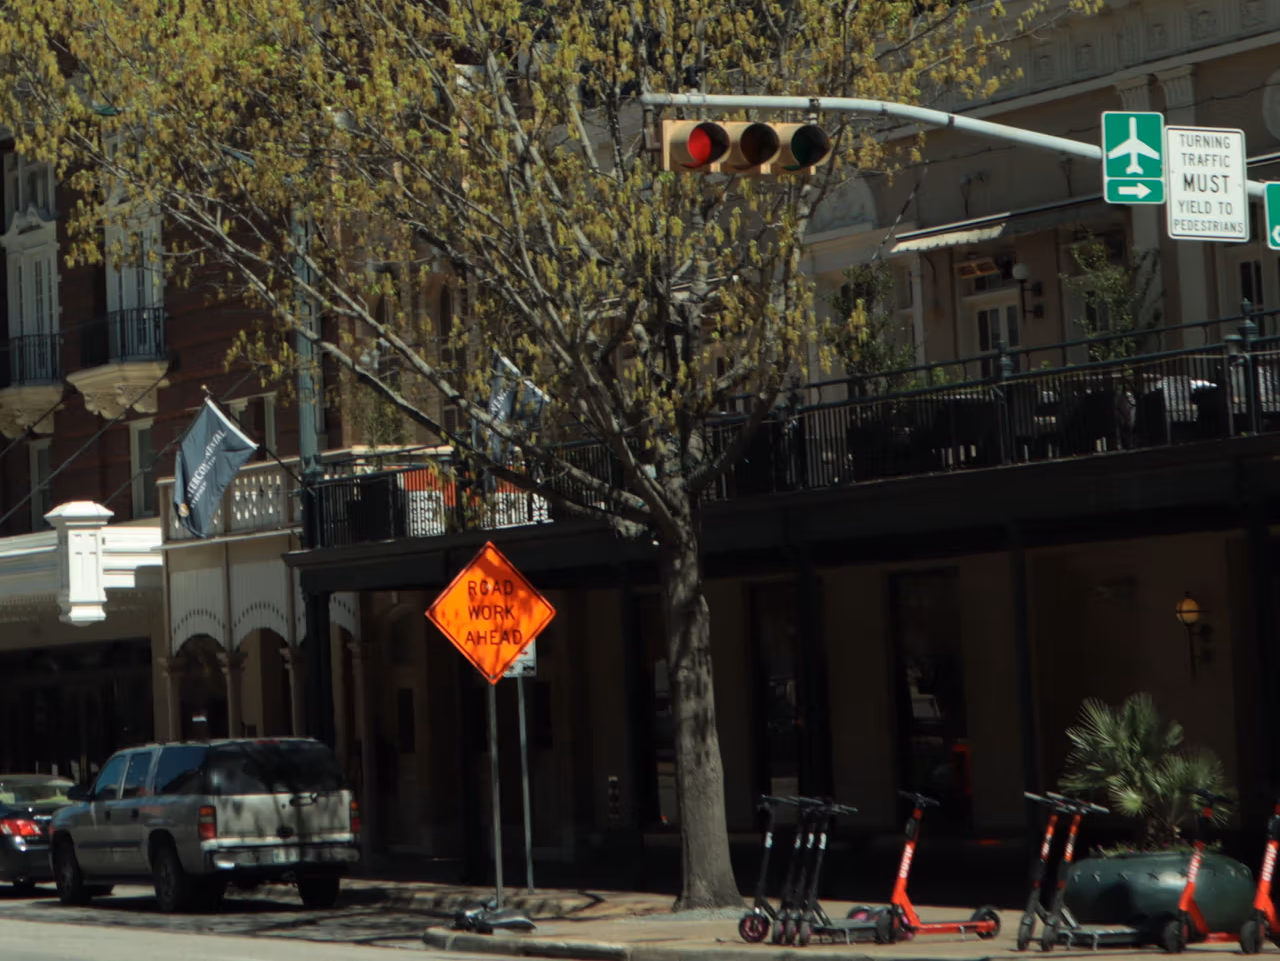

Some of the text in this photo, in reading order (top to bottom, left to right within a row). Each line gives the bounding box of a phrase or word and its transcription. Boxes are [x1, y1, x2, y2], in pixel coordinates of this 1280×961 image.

[1178, 134, 1231, 149] TURNING
[1181, 153, 1231, 168] TRAFFIC
[1183, 173, 1231, 194] MUST
[1177, 200, 1233, 216] YIELD TO
[1173, 219, 1244, 234] PEDESTRIANS
[467, 580, 514, 596] ROAD
[468, 605, 516, 621] WORK
[464, 629, 523, 646] AHEAD
